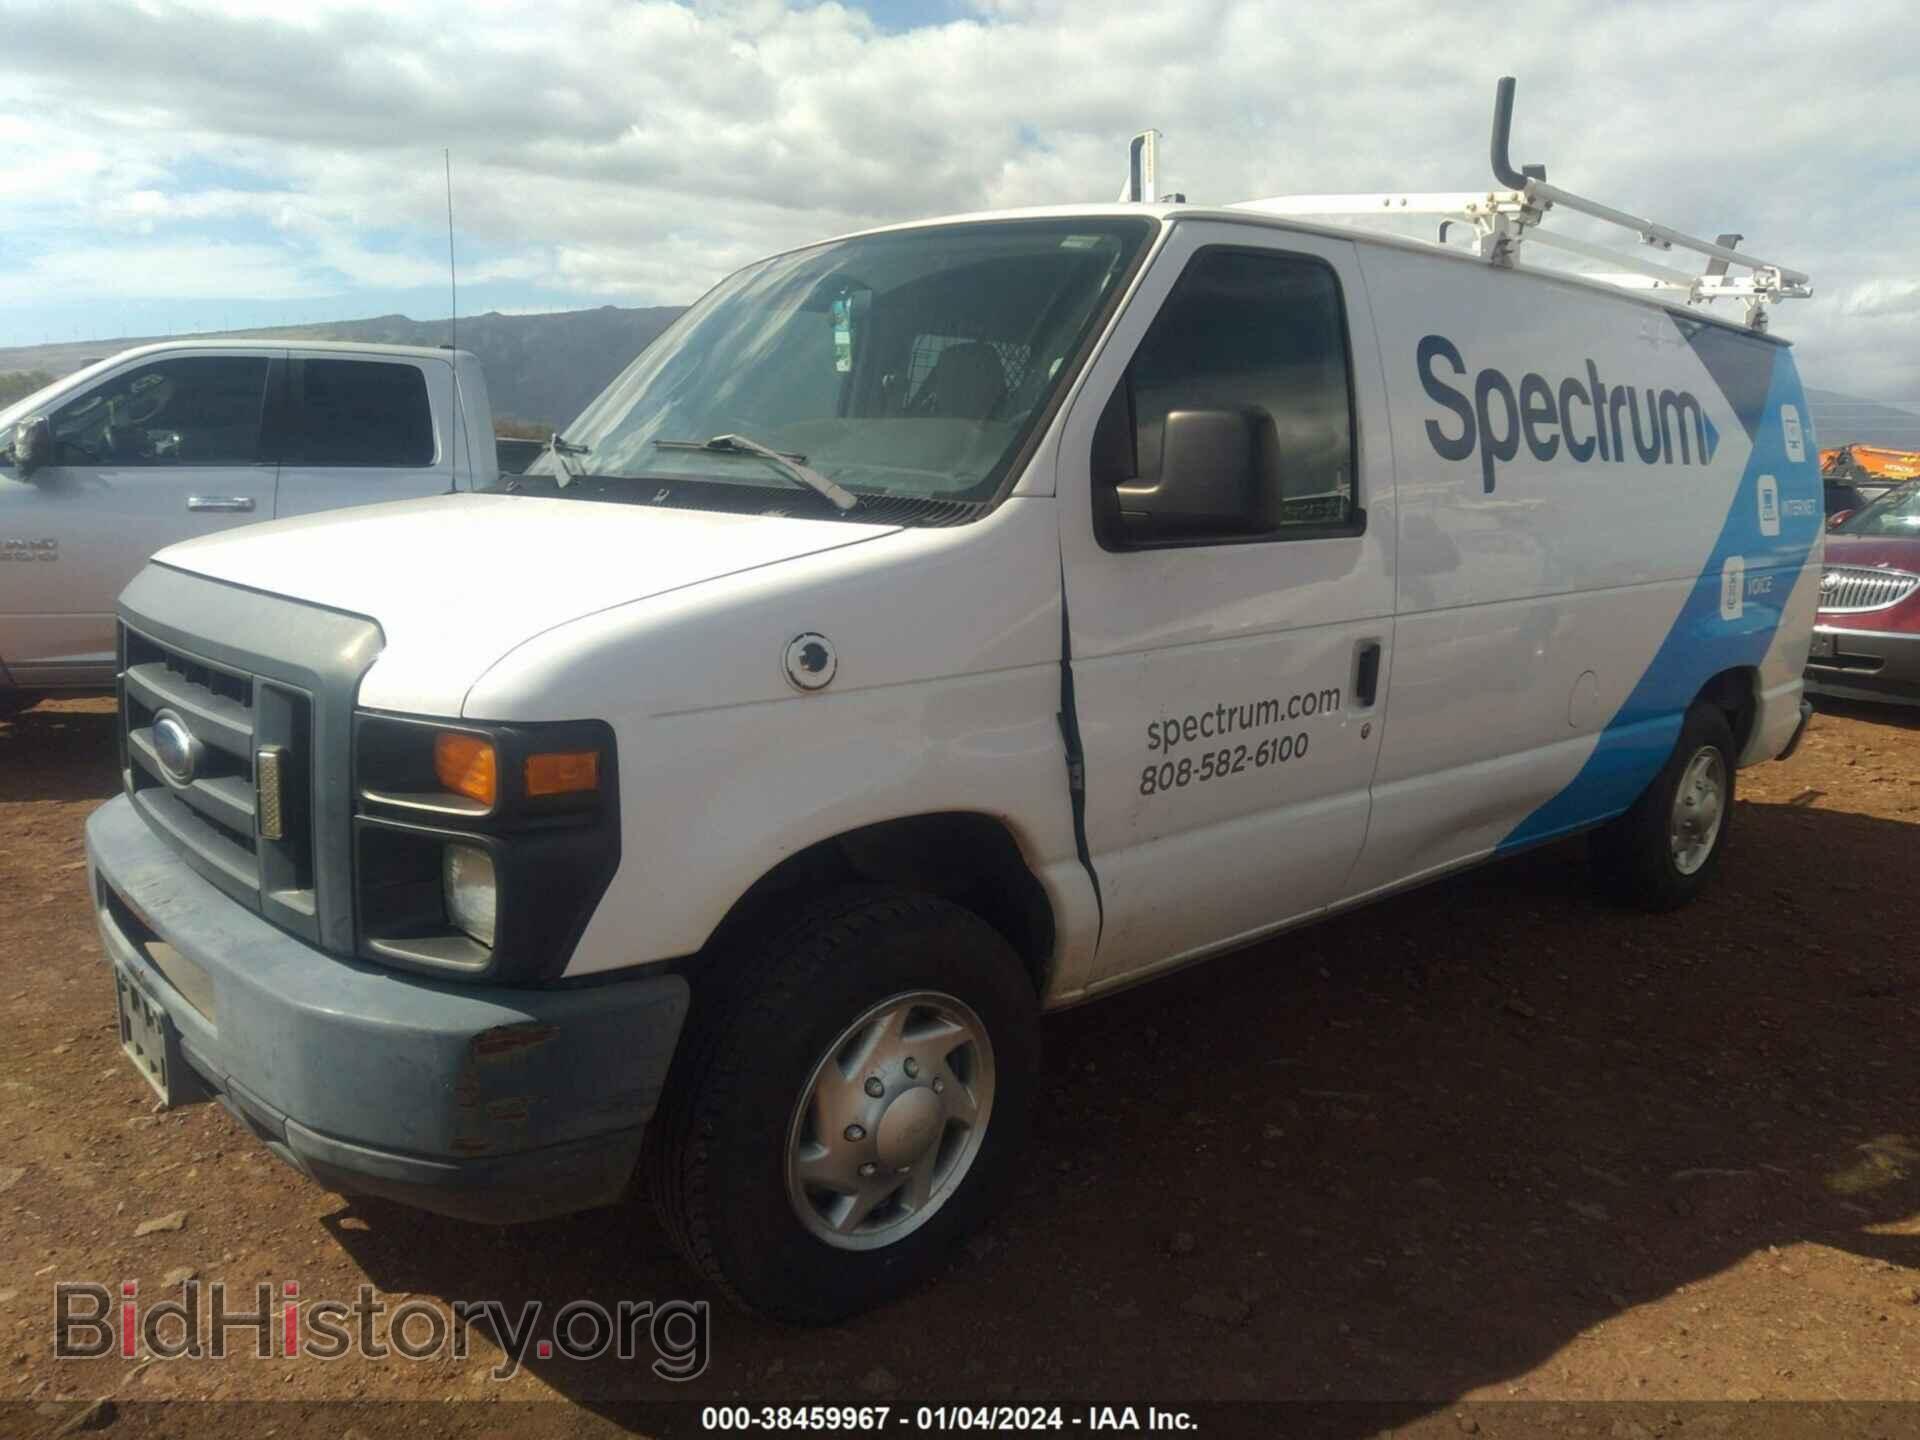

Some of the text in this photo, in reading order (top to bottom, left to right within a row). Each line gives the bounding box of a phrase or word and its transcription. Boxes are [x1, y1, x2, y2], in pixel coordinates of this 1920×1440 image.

[1417, 334, 1708, 493] Spectrum
[1147, 687, 1340, 754] spectrum.com
[1140, 732, 1308, 795] 808-582-6100
